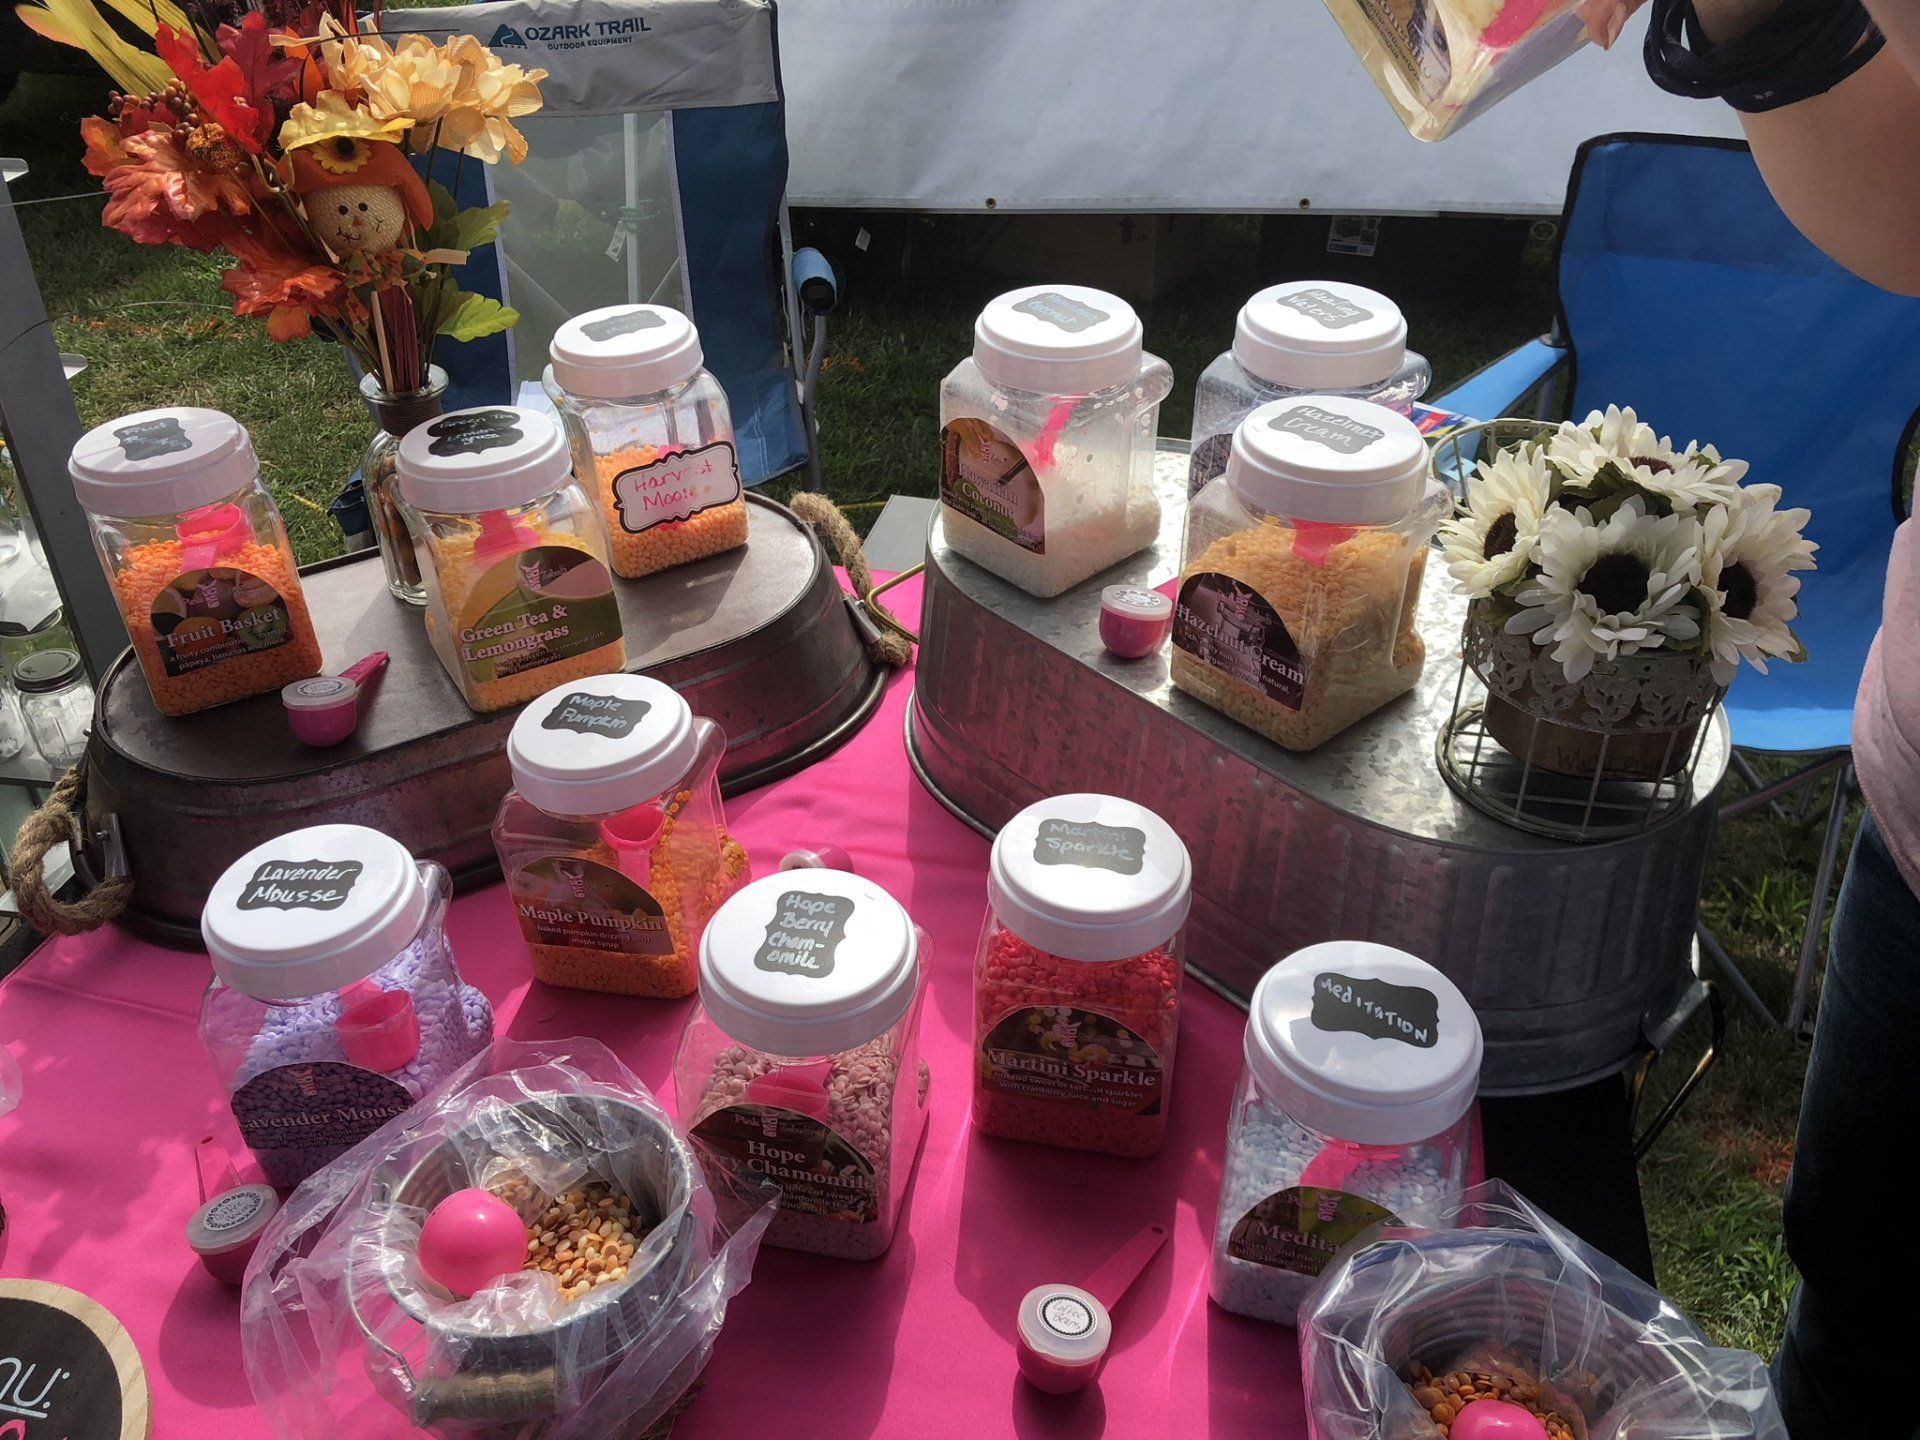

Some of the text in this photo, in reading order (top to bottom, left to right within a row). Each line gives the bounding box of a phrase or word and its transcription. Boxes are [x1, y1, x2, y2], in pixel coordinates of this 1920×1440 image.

[525, 17, 652, 41] OZARK TRAIL
[548, 36, 632, 50] OUTDOOR EQUIPMENT
[1283, 417, 1351, 447] Cream
[959, 463, 1019, 506] Hawaiian
[962, 482, 1014, 519] Coconut
[165, 609, 281, 648] Fruit Basket
[460, 604, 568, 643] Green Tea &
[461, 625, 571, 662] Lemongrass
[1176, 602, 1247, 654] Hazelnut
[1250, 645, 1304, 685] Cream
[569, 695, 622, 711] Maple
[559, 707, 628, 729] Pumpkin
[257, 865, 358, 881] Lavender
[246, 883, 344, 904] Mousse
[785, 894, 836, 915] Hope
[519, 904, 664, 933] Maple Pumpkin
[780, 911, 835, 937] Berry
[986, 1049, 1156, 1087] Martini Sparkle
[747, 1140, 806, 1165] Hope
[746, 1158, 877, 1190] Chamomile
[1257, 1220, 1339, 1252] Medita
